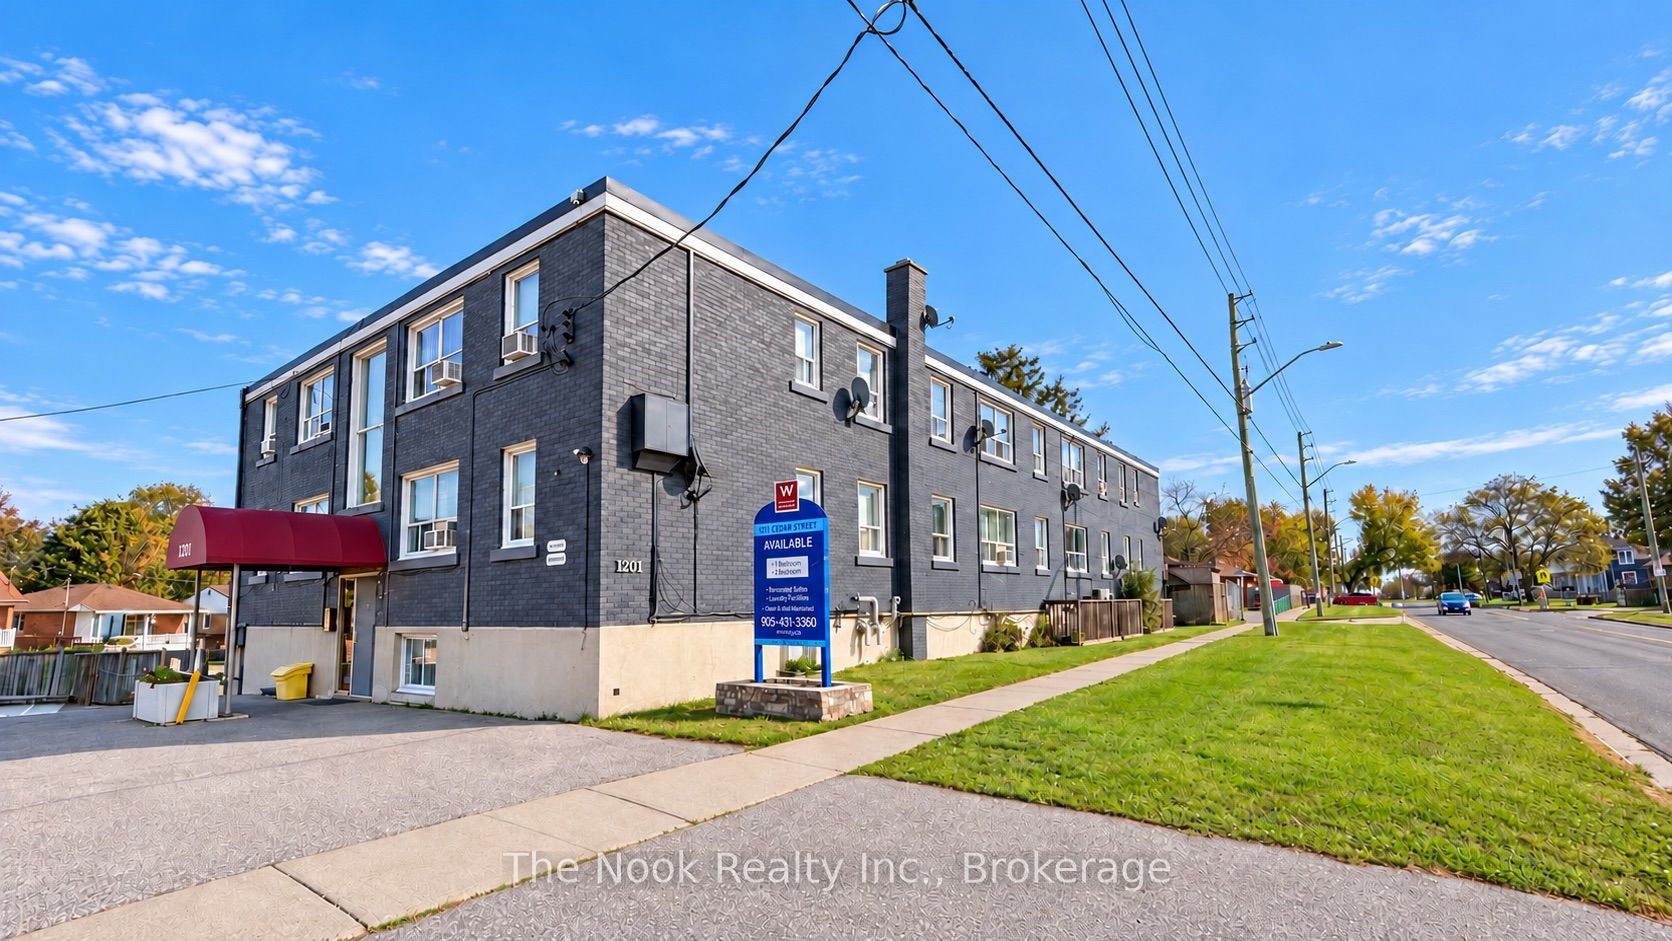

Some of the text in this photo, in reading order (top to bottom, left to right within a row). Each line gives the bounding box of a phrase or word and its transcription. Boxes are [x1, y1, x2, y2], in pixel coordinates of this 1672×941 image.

[780, 484, 794, 497] W
[771, 523, 792, 533] CEDAR
[792, 521, 817, 531] STREET
[178, 542, 192, 558] 1201
[763, 536, 813, 551] AVAILABLE
[615, 559, 643, 573] 1201
[760, 616, 817, 628] 905-431-3360
